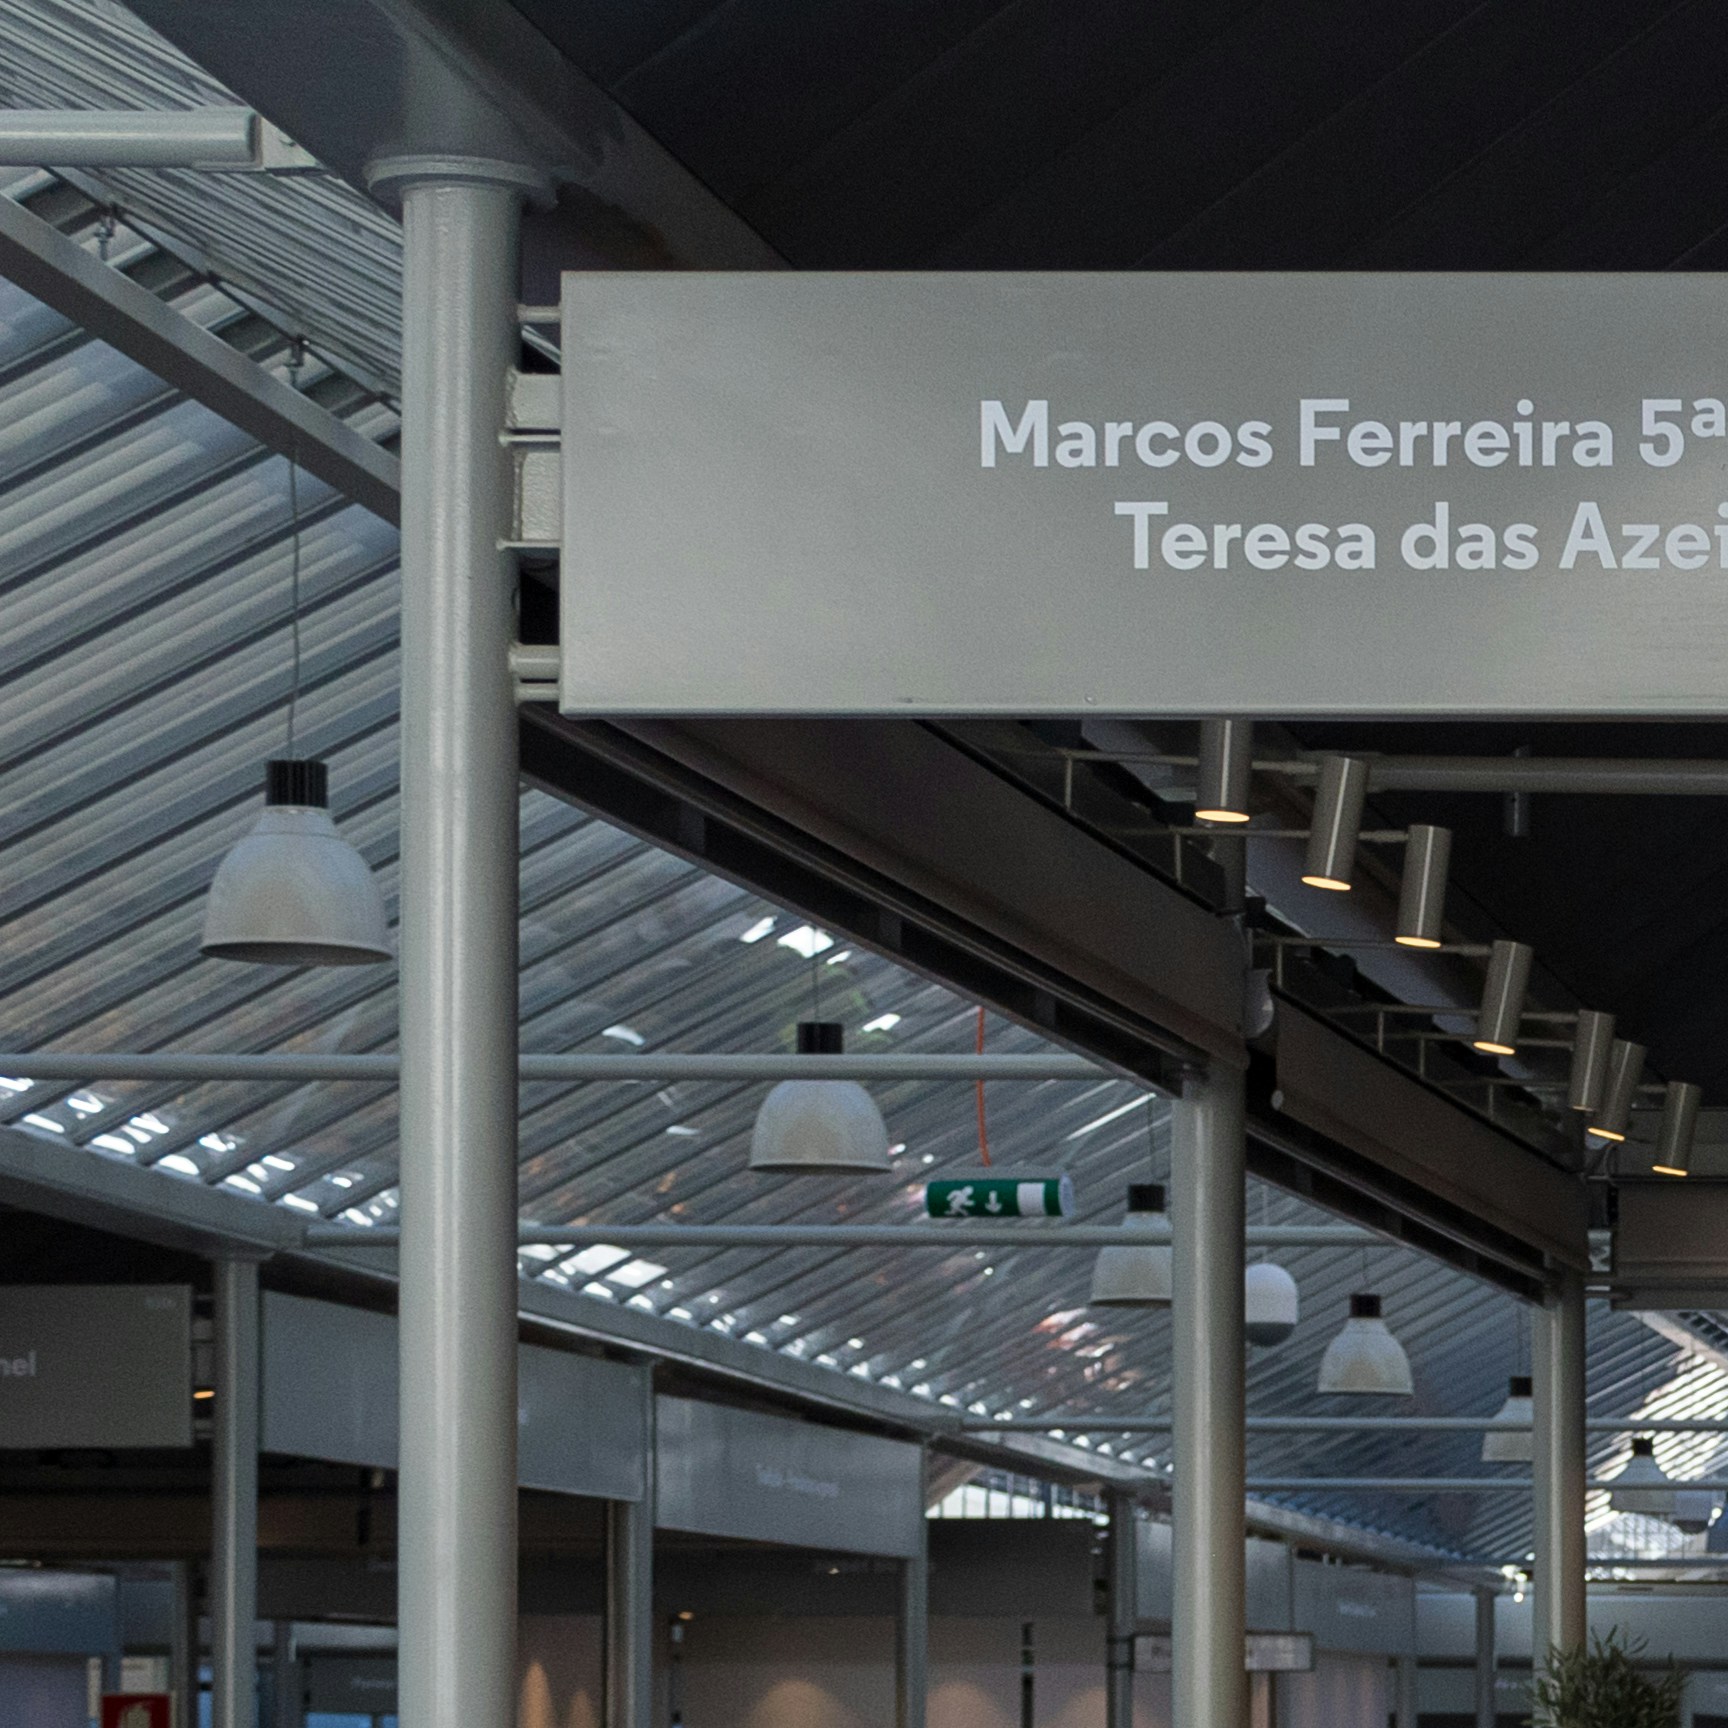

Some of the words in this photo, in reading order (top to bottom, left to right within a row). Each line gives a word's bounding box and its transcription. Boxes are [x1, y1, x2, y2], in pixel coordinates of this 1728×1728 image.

[980, 399, 1273, 468] Marcos
[1299, 398, 1613, 468] Ferreira
[1639, 397, 1726, 467] 5ª
[1113, 501, 1376, 571] Teresa
[1400, 500, 1539, 570] das
